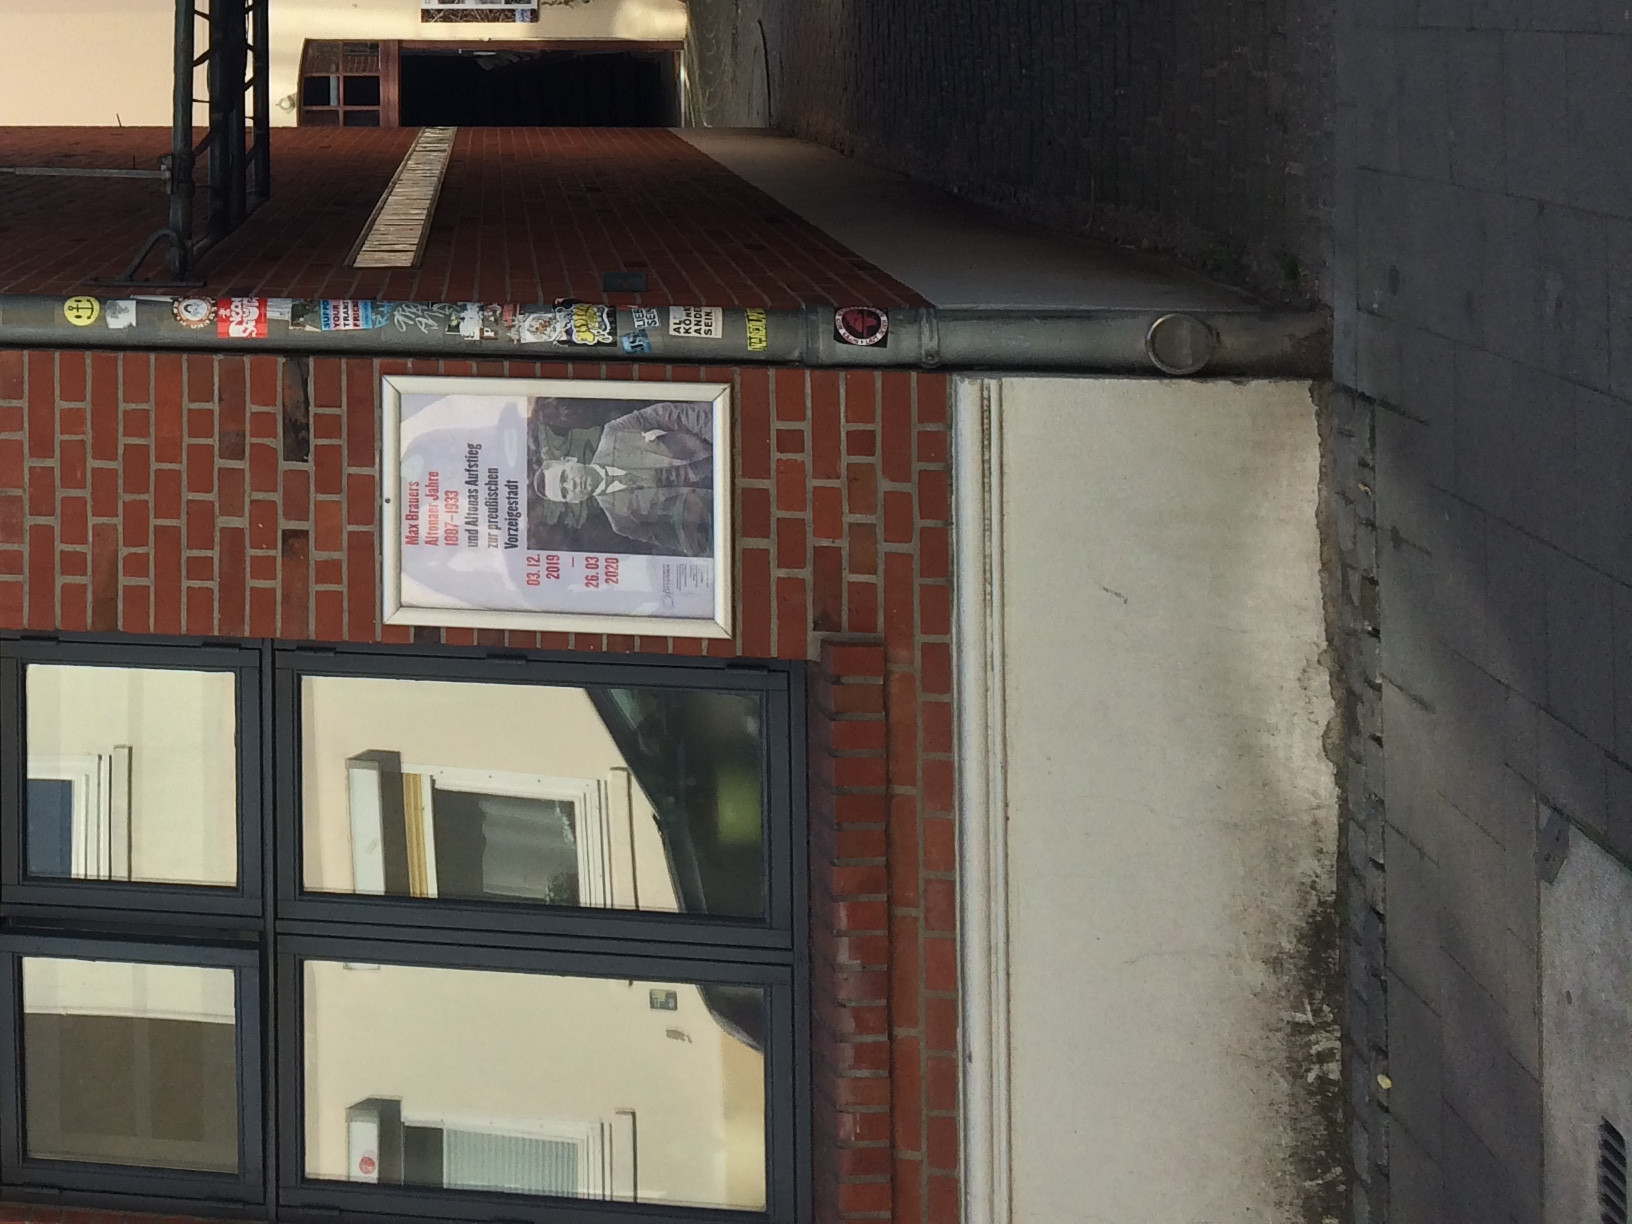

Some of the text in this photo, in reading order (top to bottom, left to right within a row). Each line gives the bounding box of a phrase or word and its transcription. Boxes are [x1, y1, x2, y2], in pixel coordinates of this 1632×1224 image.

[332, 304, 341, 328] YOUR
[405, 481, 420, 546] Max Brauers
[425, 471, 440, 547] Altonaer Jahre
[465, 443, 483, 548] und Altonas Aufstieg
[484, 467, 502, 549] zur preußischen
[504, 479, 522, 550] Vorzeigestadt
[546, 555, 560, 580] 2019
[605, 557, 619, 584] 2020
